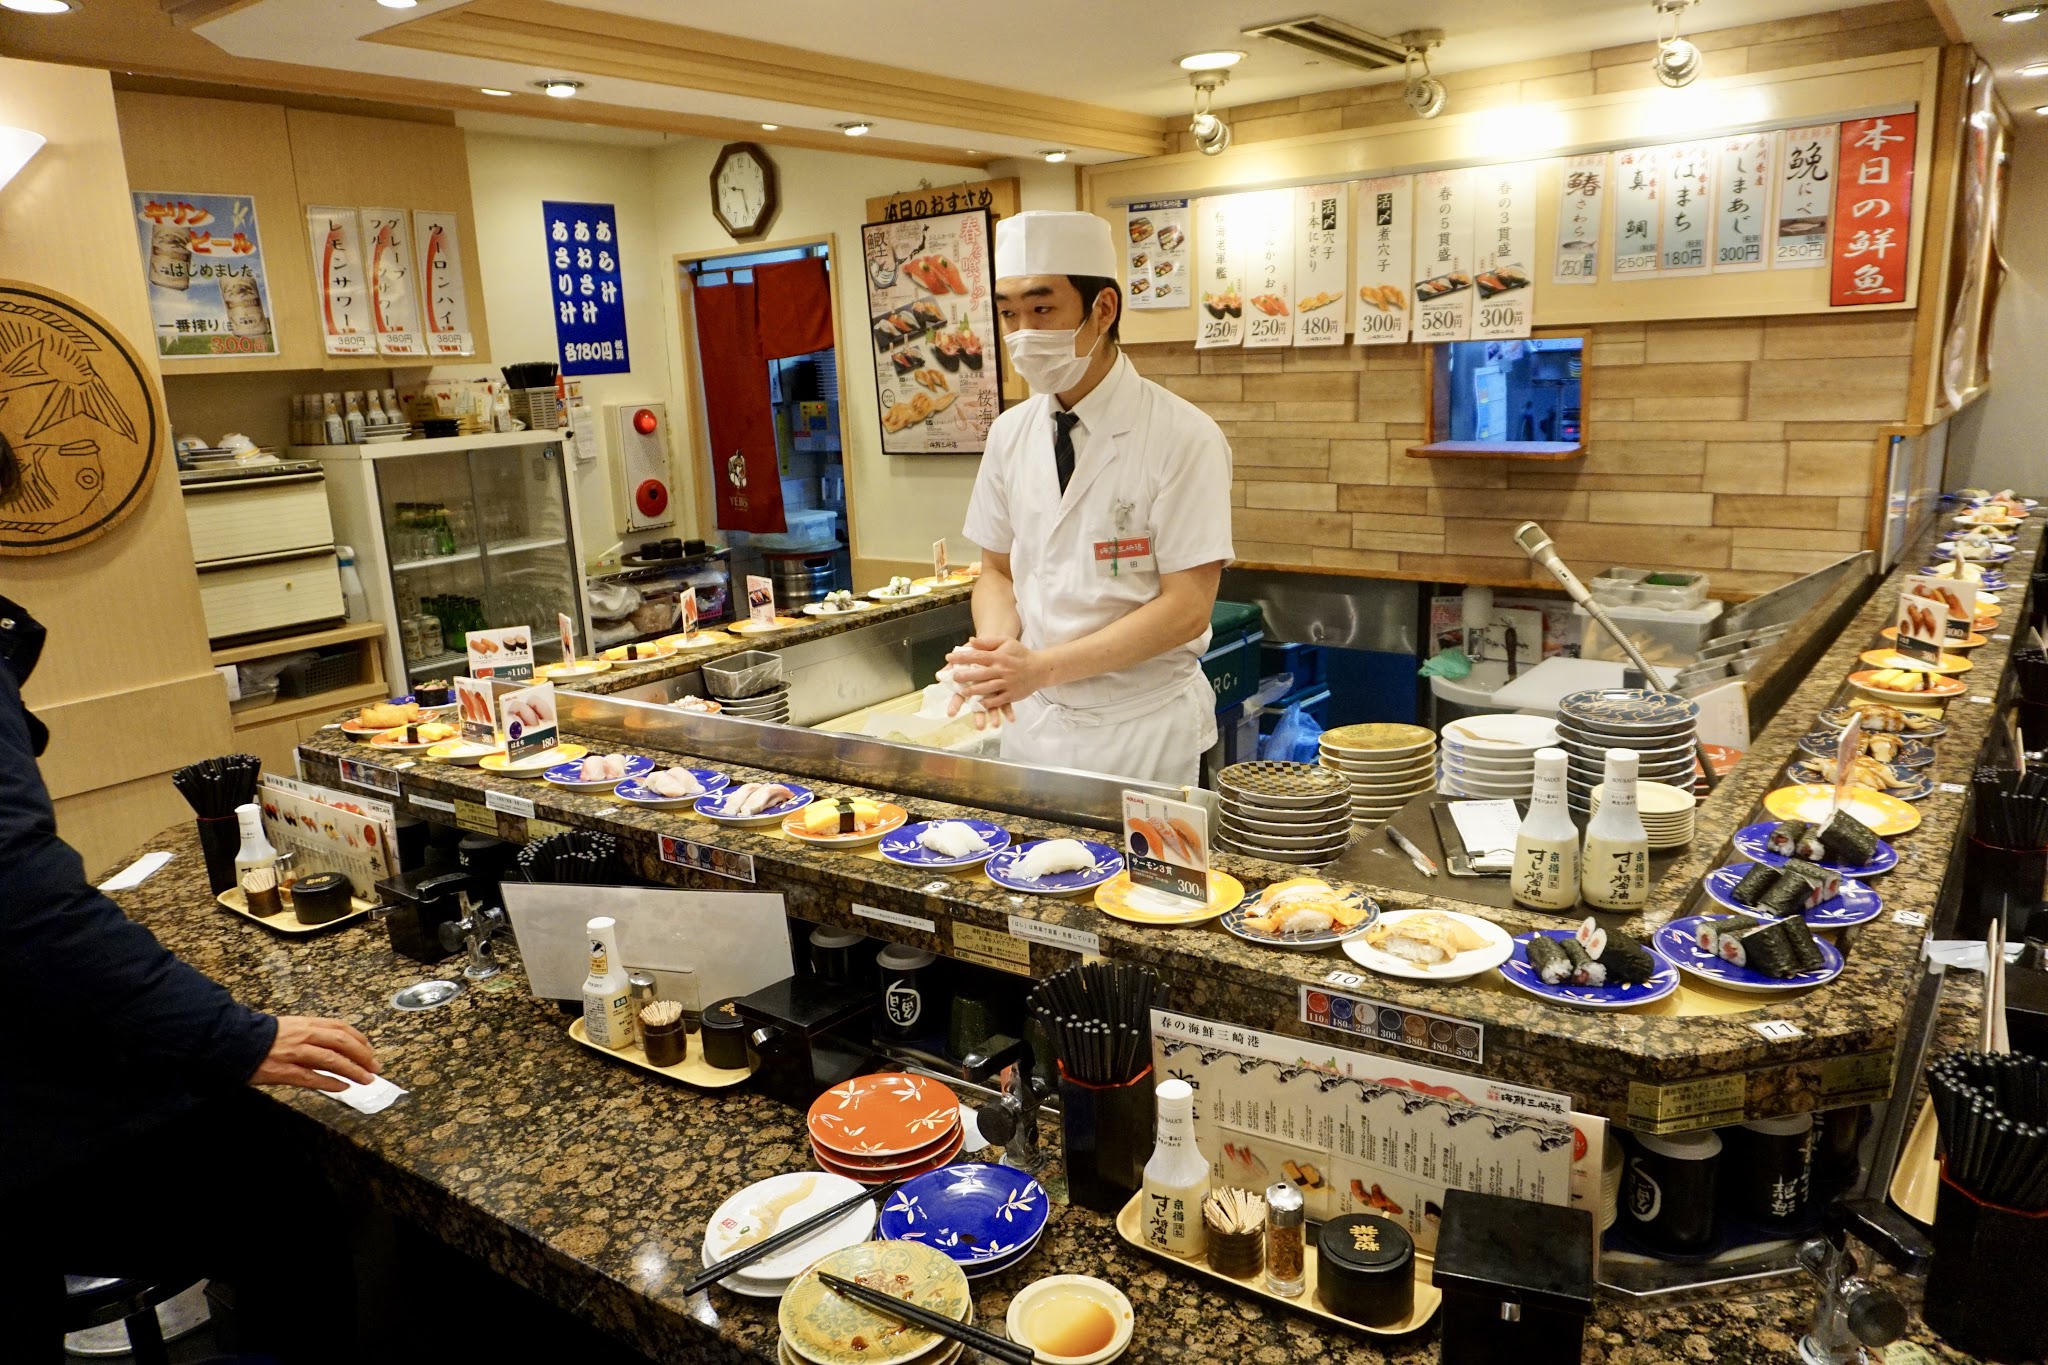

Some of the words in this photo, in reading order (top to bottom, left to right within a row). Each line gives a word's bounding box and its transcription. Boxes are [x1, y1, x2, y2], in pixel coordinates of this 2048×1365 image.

[1625, 169, 1648, 239] 真鯛
[1674, 163, 1696, 232] はまち
[1728, 157, 1750, 234] しまあじ
[144, 201, 209, 225] キリン
[1844, 119, 1905, 295] 本日の鮮魚
[1438, 186, 1452, 262] 春の5貫盛
[1497, 181, 1512, 258] 春の3貫盛
[189, 230, 253, 254] ビール
[1308, 202, 1320, 272] 1本にぎり
[388, 218, 407, 279] グレープ
[1664, 249, 1702, 265] 180円
[1720, 245, 1759, 261] 300円
[1778, 244, 1823, 259] 250円
[170, 262, 261, 280] はじめました。
[328, 219, 352, 326] レモンサワー
[552, 219, 577, 324] あさり汁
[574, 219, 599, 324] あおさ汁
[595, 220, 618, 304] あら汁
[1561, 258, 1593, 276] 250円
[1618, 255, 1656, 269] 250円
[429, 223, 455, 325] ウーロンハイ
[158, 318, 219, 333] 一番搾り
[1251, 319, 1286, 337] 250円
[1302, 316, 1338, 335] 480円
[1362, 314, 1402, 332] 300円
[1421, 311, 1462, 330] 580円
[1480, 308, 1523, 328] 300円
[387, 334, 413, 344] 380円
[436, 334, 462, 344] 380円
[1204, 321, 1238, 339] 250円
[211, 336, 267, 354] 300円
[337, 336, 366, 346] 380円
[564, 341, 613, 362] 各180円
[1131, 857, 1173, 875] サーモン3貫
[1524, 849, 1547, 897] すし醤油
[1609, 851, 1634, 900] すし醤油
[1177, 879, 1205, 898] 300円
[1332, 973, 1359, 985] 10
[1160, 1016, 1260, 1048] 春の海鮮三崎港
[1764, 1023, 1794, 1035] 11
[1501, 1093, 1565, 1115] 海鮮三崎港
[1150, 1193, 1171, 1246] すし醤油
[1172, 1199, 1184, 1222] 京樽
